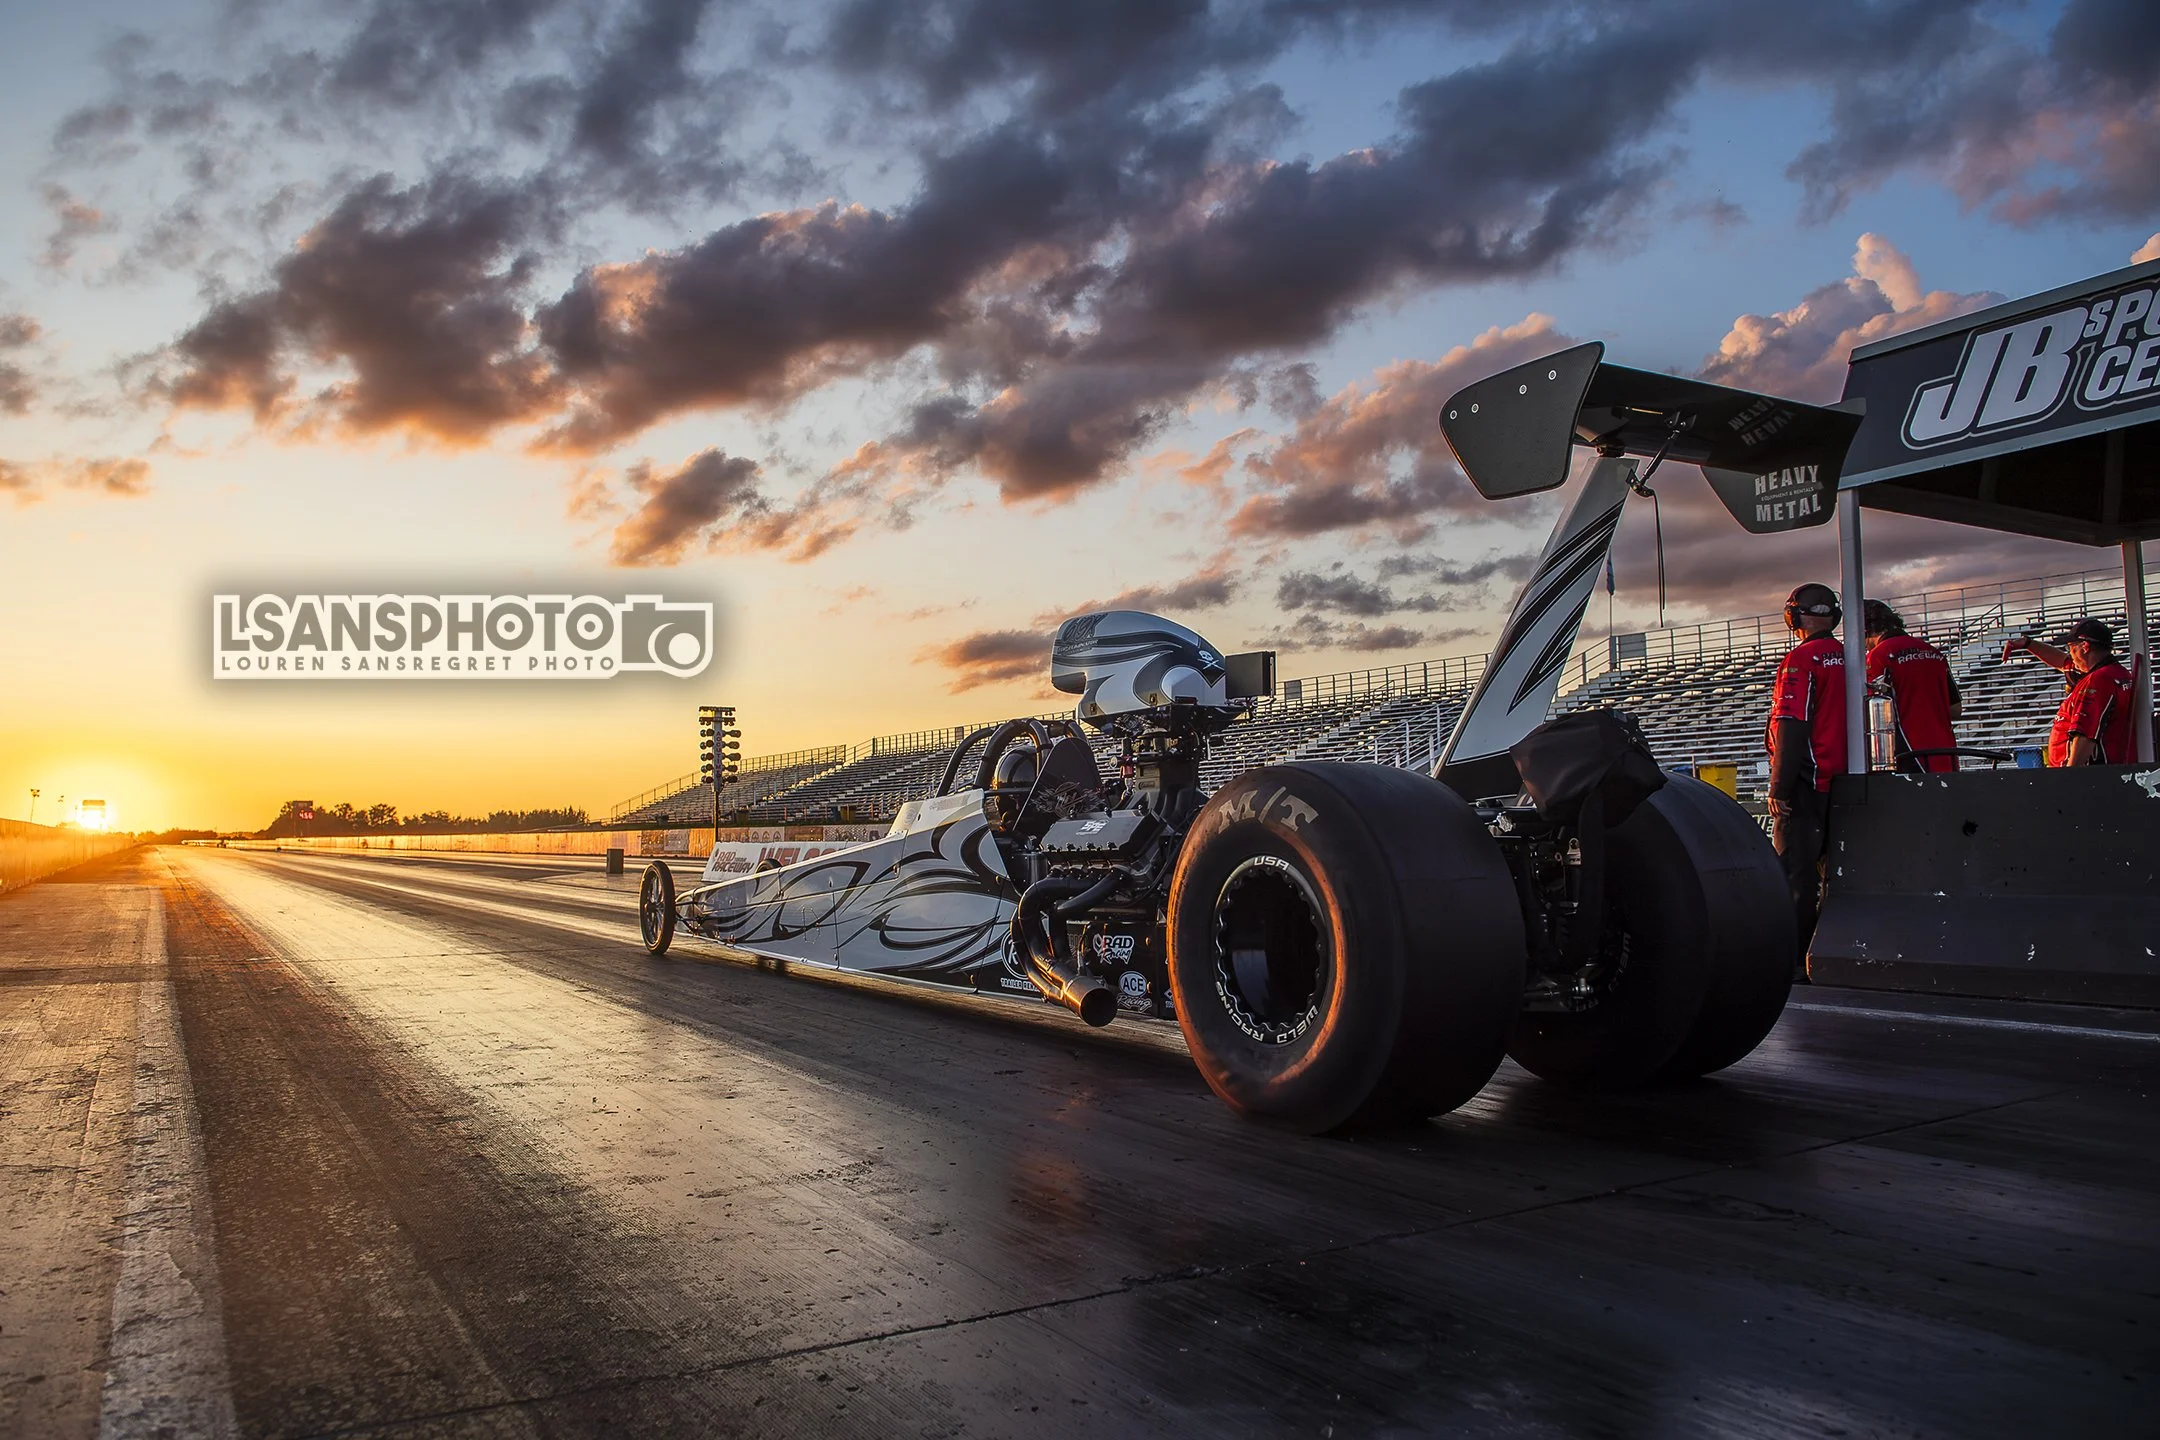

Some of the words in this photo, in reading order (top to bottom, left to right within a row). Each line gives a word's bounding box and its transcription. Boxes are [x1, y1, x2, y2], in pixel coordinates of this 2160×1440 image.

[1910, 307, 2088, 441] JB
[2084, 338, 2160, 401] CE
[1755, 465, 1818, 496] HEAVY
[1761, 491, 1788, 502] EQUIPMENT
[1794, 486, 1814, 495] RENTALS
[1756, 493, 1821, 522] METAL
[1897, 652, 1944, 665] RACEWAY
[1218, 786, 1319, 834] M/T
[716, 851, 736, 861] RAD
[1253, 855, 1290, 871] USA
[711, 861, 755, 873] RACEWAY
[1104, 937, 1134, 949] RAD
[1099, 947, 1132, 965] Racing
[1122, 977, 1145, 992] ACE
[1117, 993, 1152, 1013] Racing
[1215, 981, 1265, 1042] RACING
[1276, 1005, 1318, 1044] WELD
